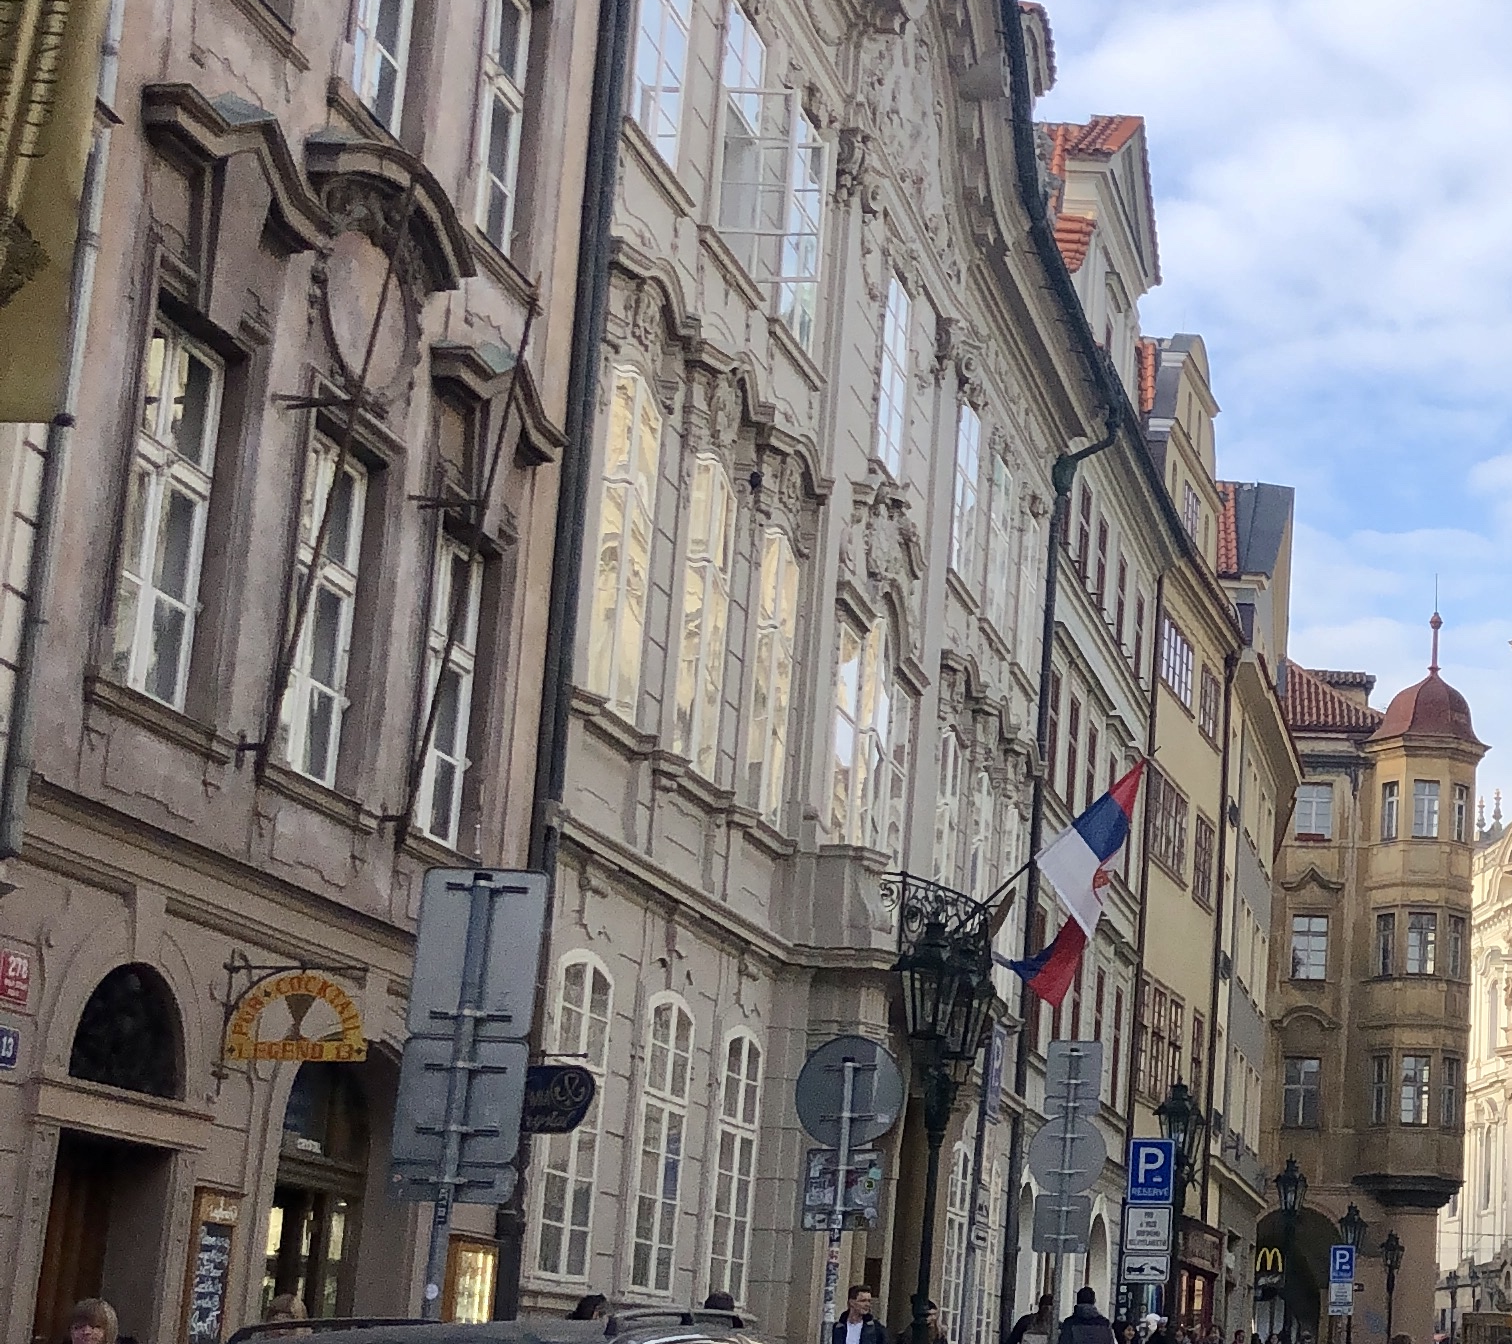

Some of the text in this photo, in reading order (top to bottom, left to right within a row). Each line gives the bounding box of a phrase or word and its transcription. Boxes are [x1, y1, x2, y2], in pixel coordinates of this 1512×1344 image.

[275, 974, 361, 1037] COCKTAIL
[1138, 1146, 1165, 1184] P
[1335, 1250, 1350, 1270] P
